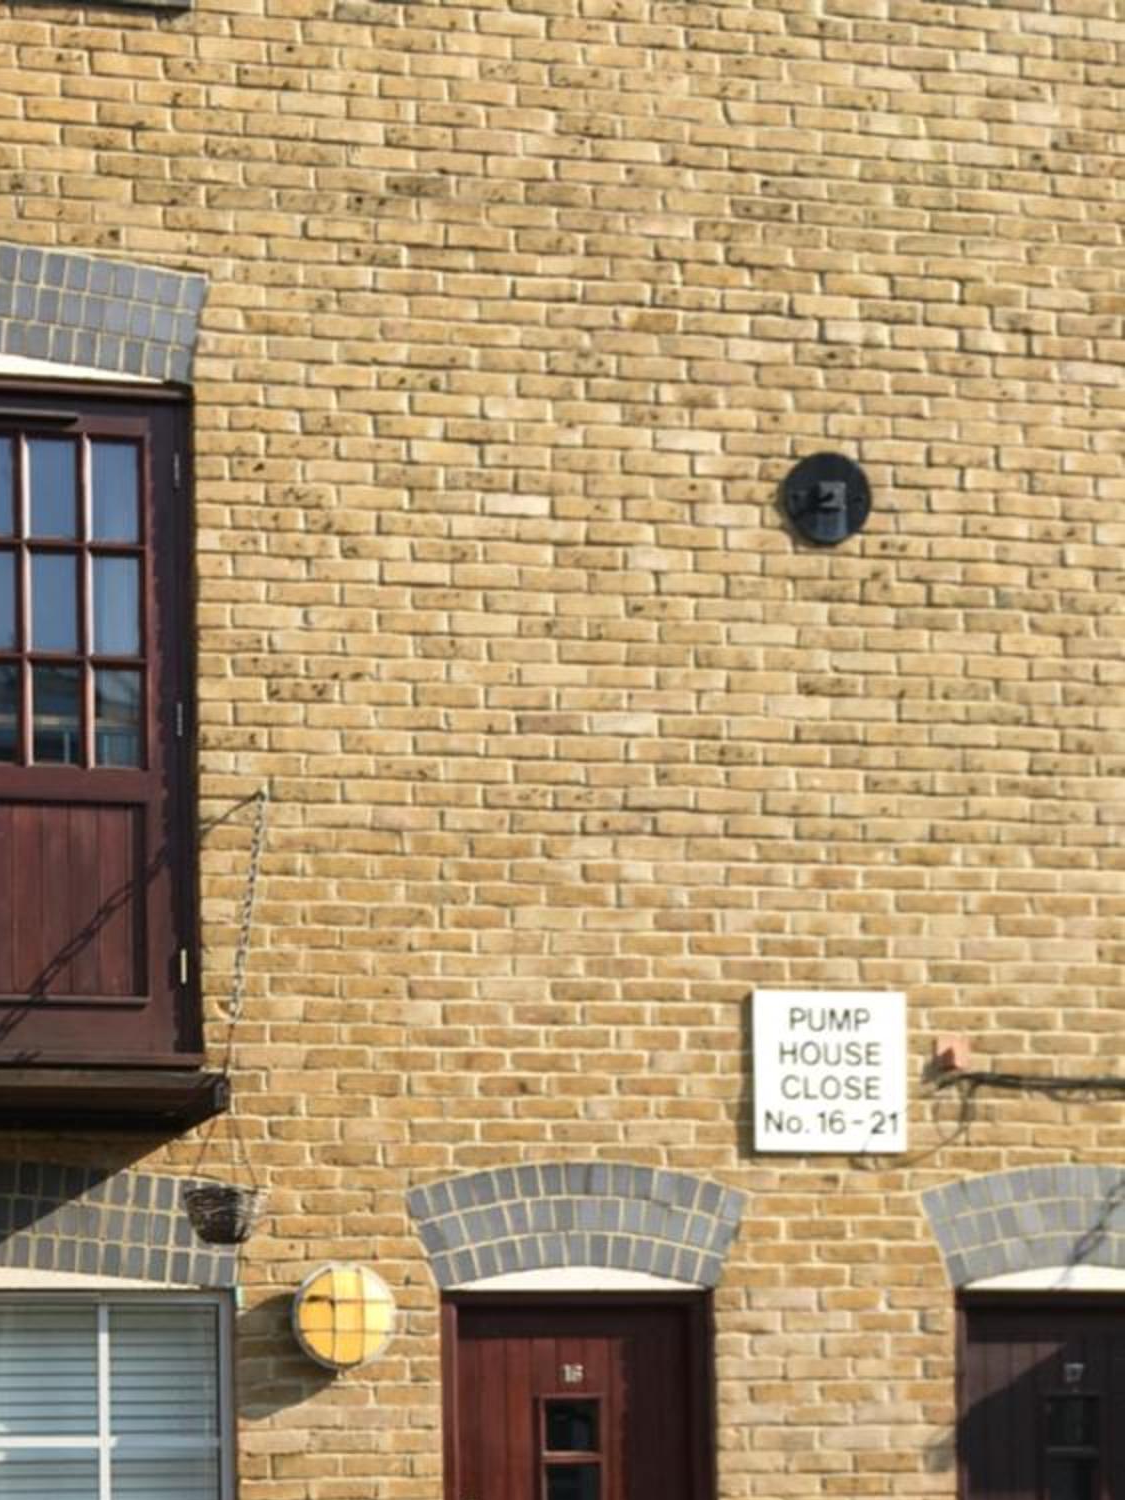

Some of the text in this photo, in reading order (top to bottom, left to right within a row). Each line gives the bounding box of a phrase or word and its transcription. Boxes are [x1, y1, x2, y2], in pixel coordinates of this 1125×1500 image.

[789, 1007, 870, 1031] PUMP
[779, 1041, 881, 1066] HOUSE
[780, 1074, 881, 1100] CLOSE
